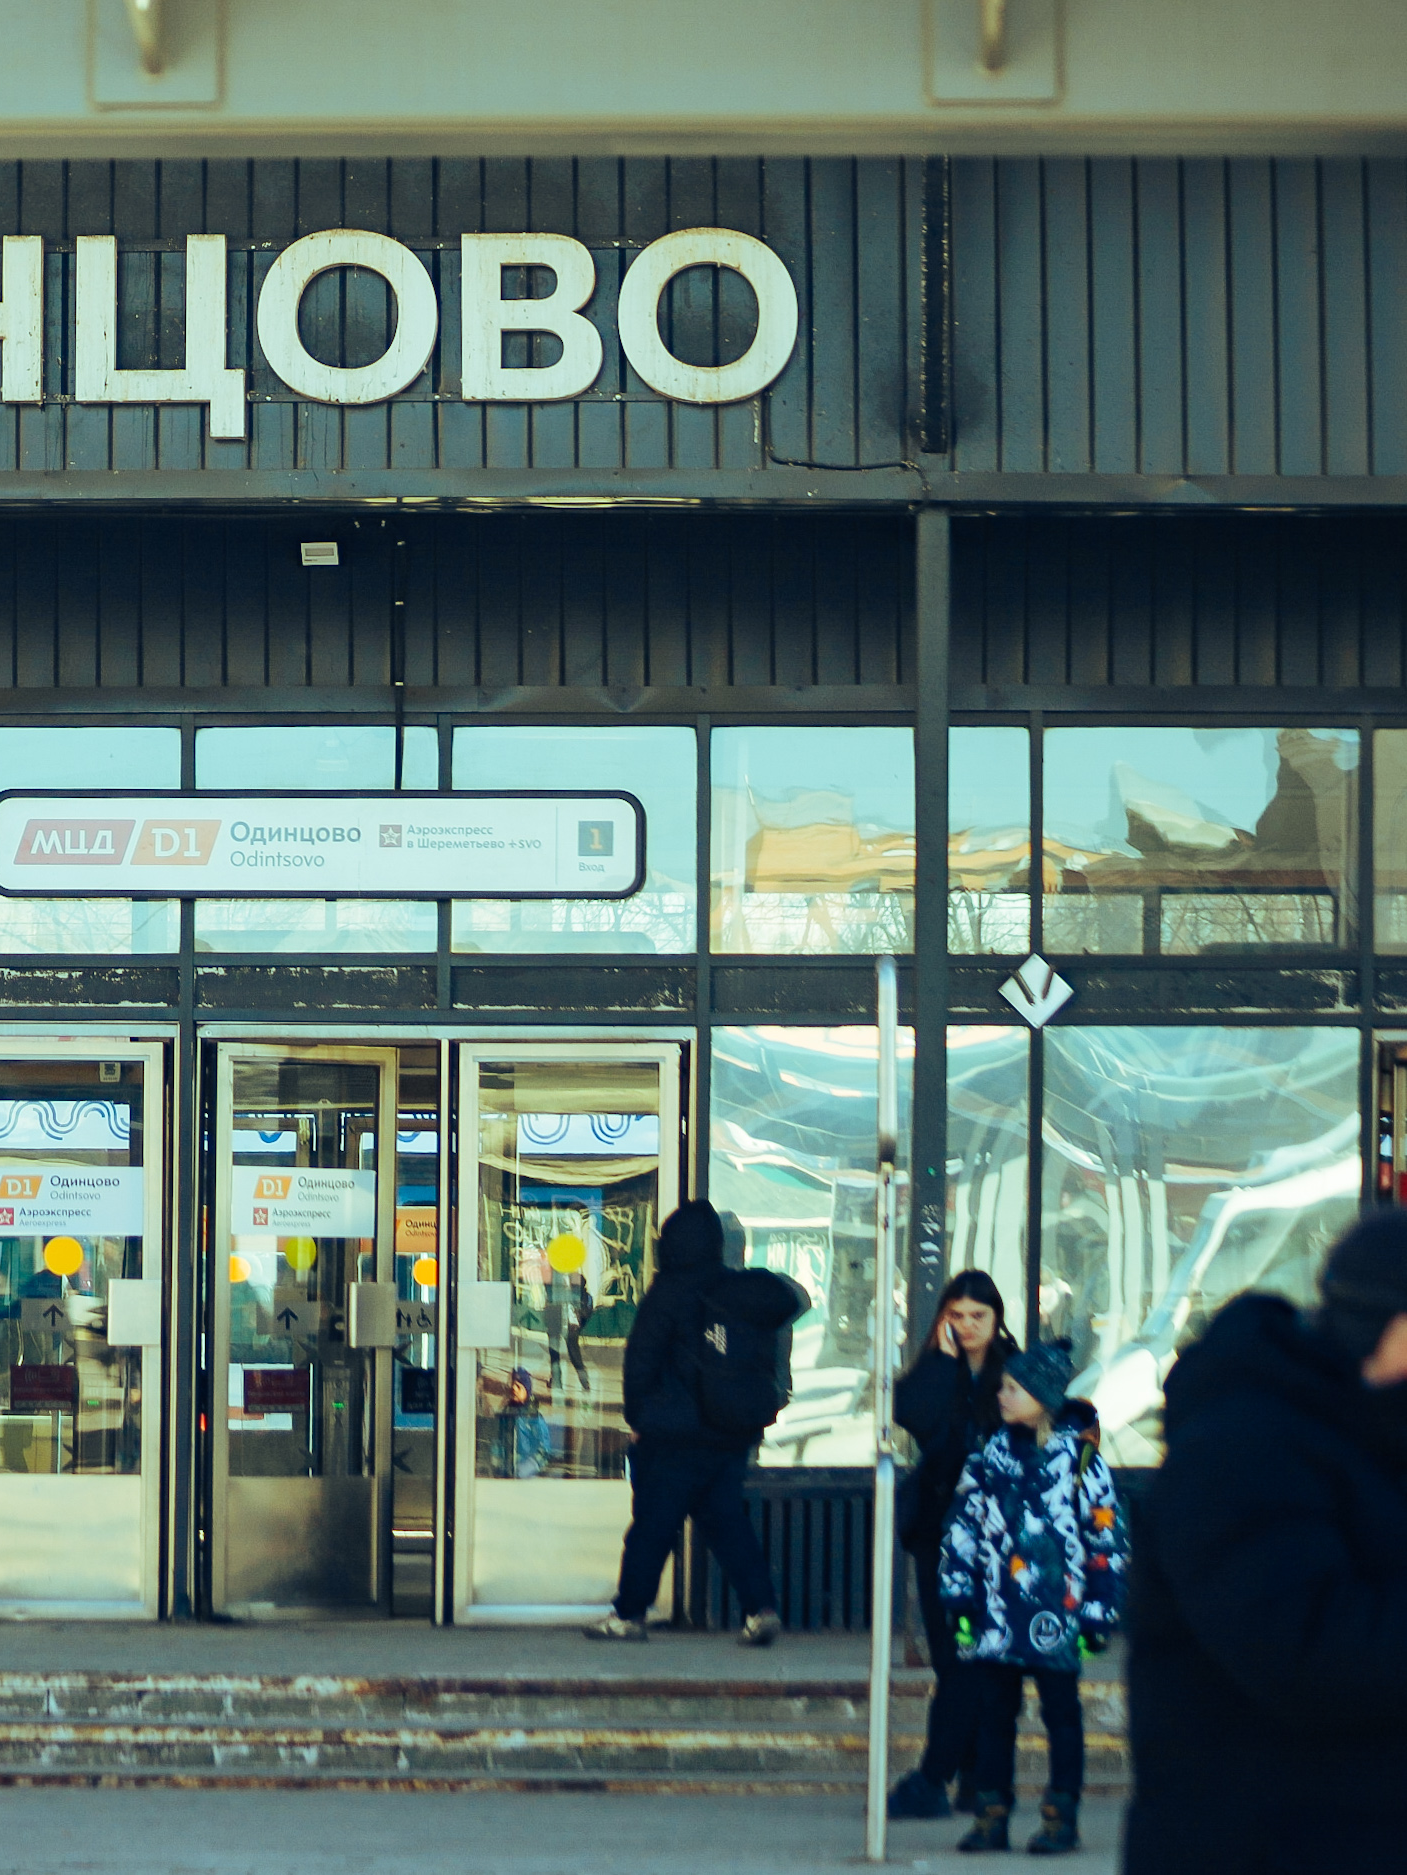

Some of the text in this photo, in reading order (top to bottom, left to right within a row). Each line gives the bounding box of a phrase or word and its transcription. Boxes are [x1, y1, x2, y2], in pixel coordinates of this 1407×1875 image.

[230, 821, 362, 846] Одинцово
[407, 825, 494, 837] Аэроэкспресс
[30, 829, 115, 855] МЦД
[151, 828, 201, 857] D1
[407, 841, 414, 849] в
[417, 839, 505, 850] Шереметьево
[589, 828, 604, 850] 1
[229, 850, 325, 868] Odintsovo
[578, 862, 605, 873] Вход
[6, 1179, 32, 1196] D1
[50, 1175, 120, 1188] Одинцово
[262, 1179, 284, 1196] D1
[297, 1176, 355, 1190] Одинцово
[50, 1190, 101, 1200] Odintsovo
[297, 1191, 340, 1202] Odintsovo
[19, 1207, 92, 1218] Аэроэкспресс
[272, 1207, 332, 1219] Аэроэкспресс
[19, 1219, 67, 1228] Aeroexpress
